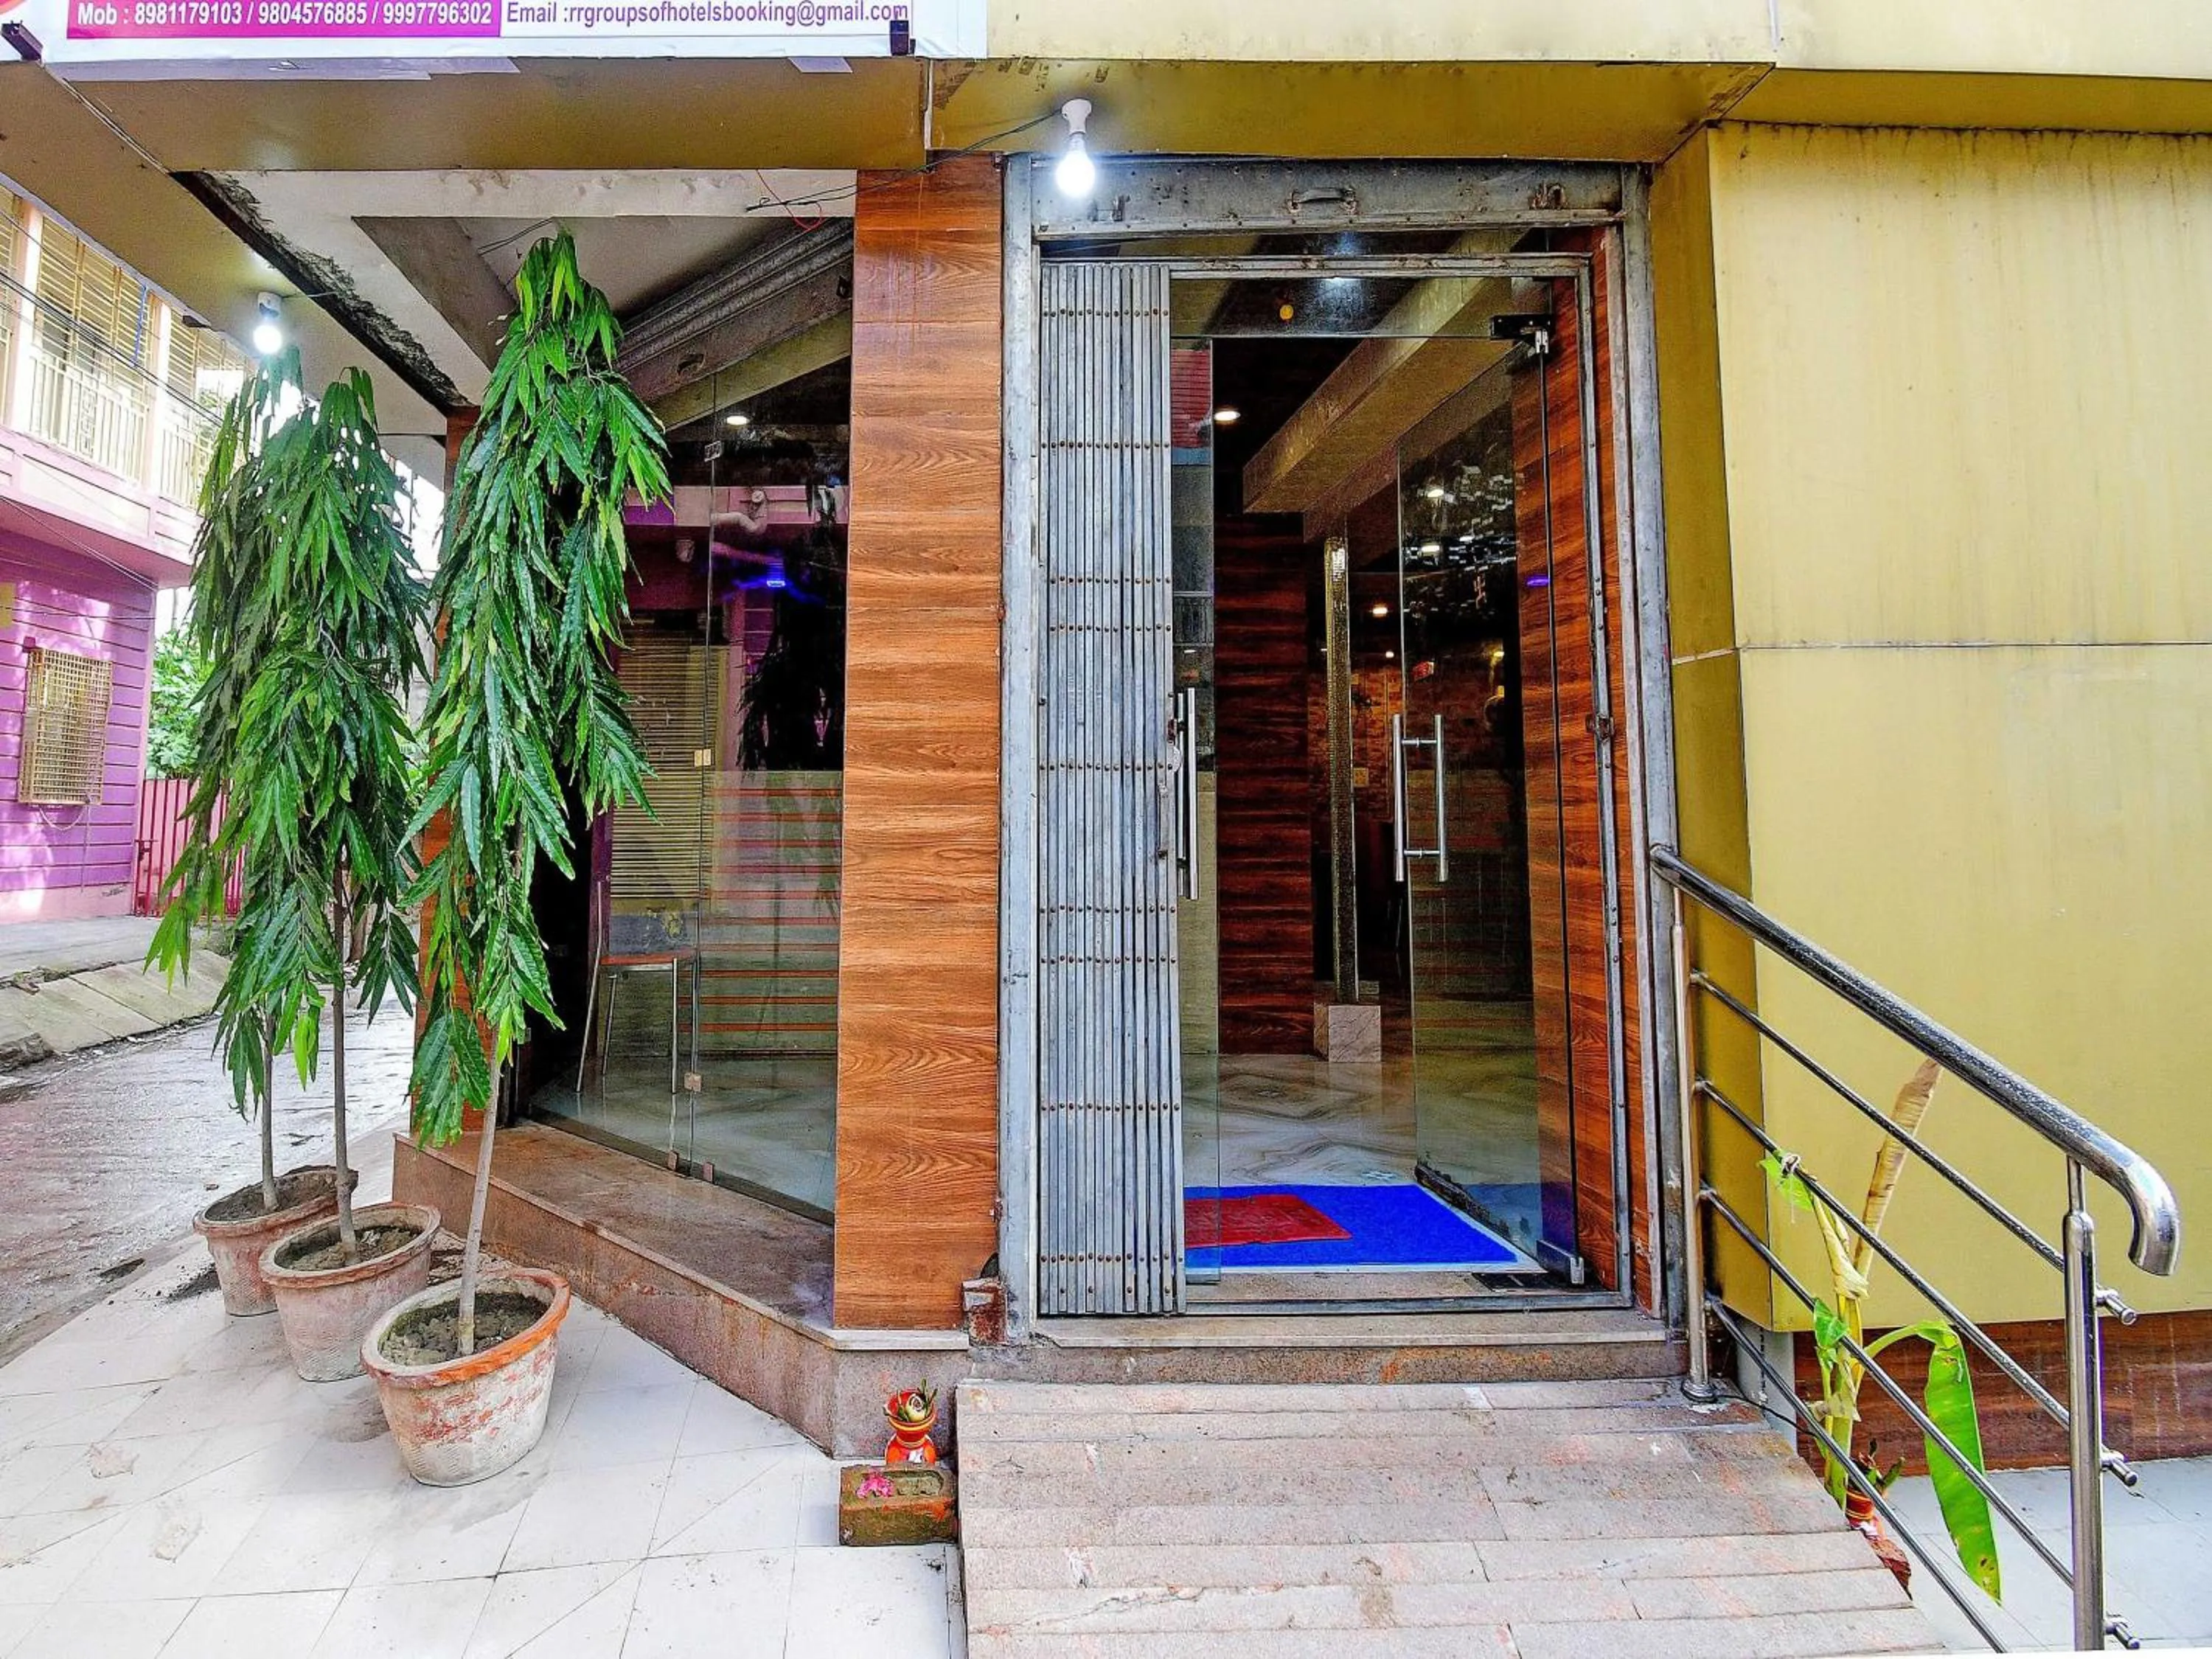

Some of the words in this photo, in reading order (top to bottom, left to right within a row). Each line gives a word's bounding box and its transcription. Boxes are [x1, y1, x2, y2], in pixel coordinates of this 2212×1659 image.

[77, 2, 117, 24] Mob
[123, 7, 129, 24] :
[135, 1, 243, 24] 8981179103
[246, 1, 254, 24] /
[259, 1, 367, 24] 9804576885
[371, 1, 379, 24] /
[383, 1, 493, 24] 9997796302
[507, 1, 557, 23] Email
